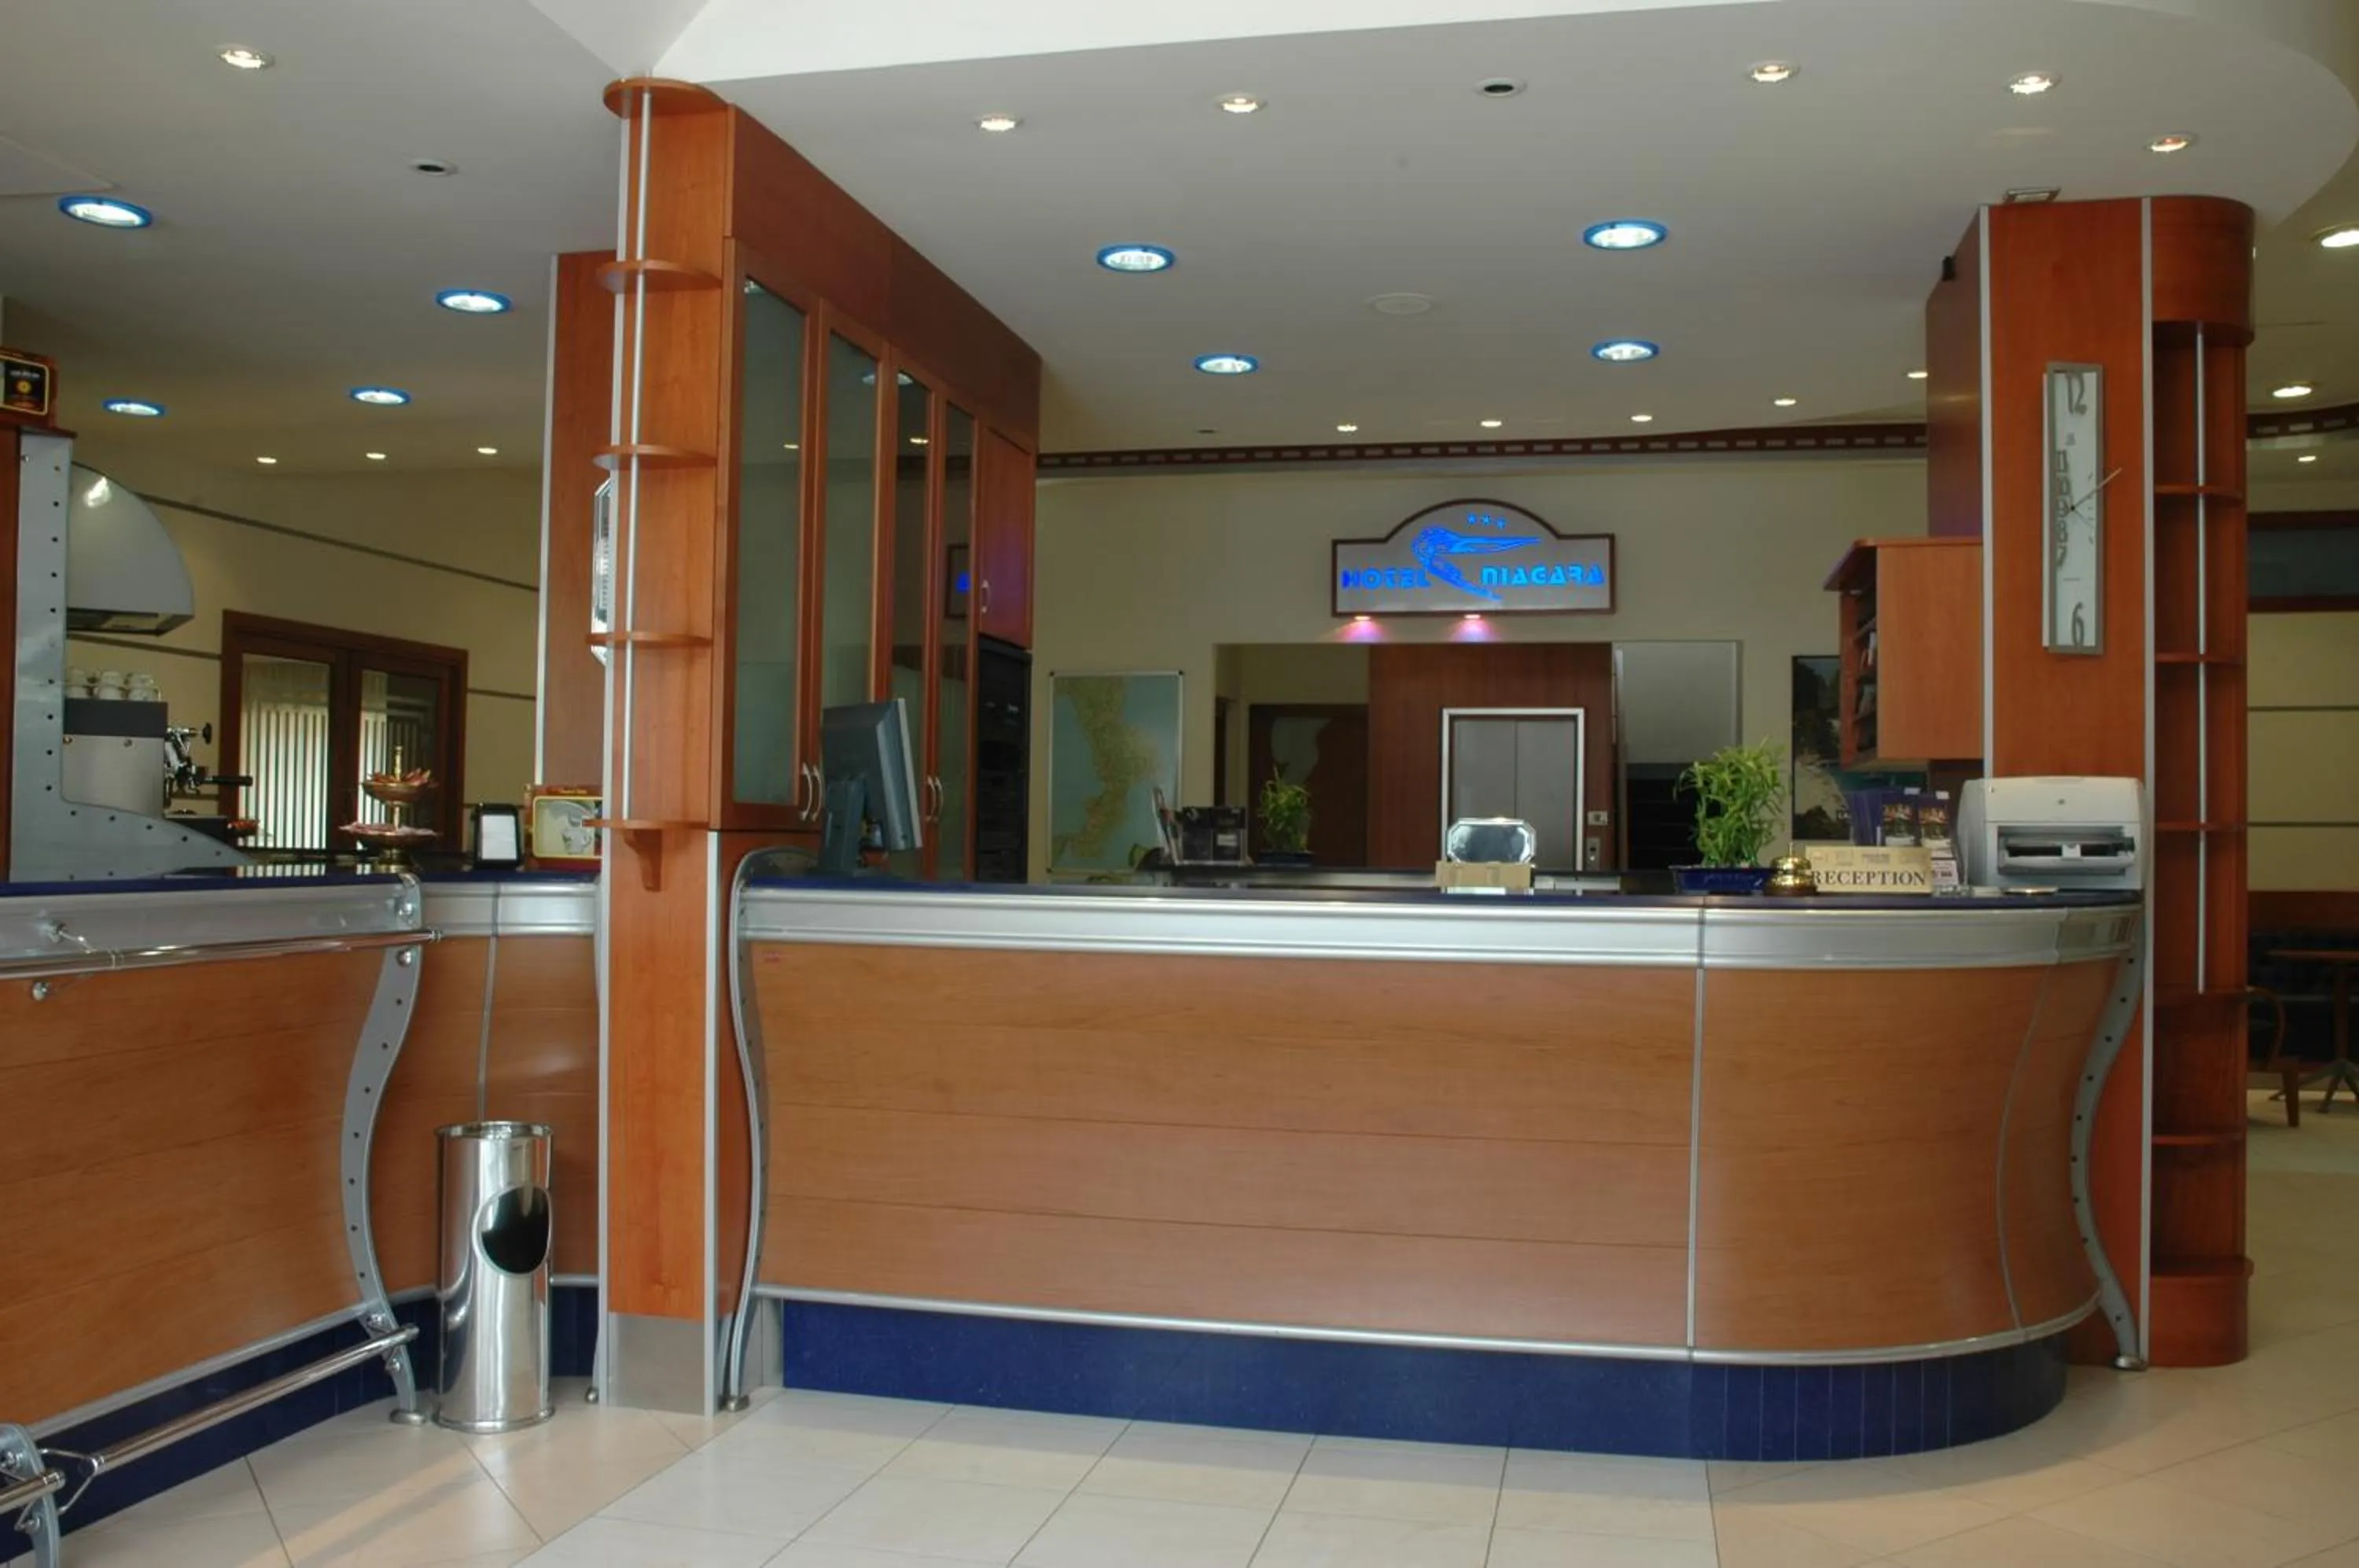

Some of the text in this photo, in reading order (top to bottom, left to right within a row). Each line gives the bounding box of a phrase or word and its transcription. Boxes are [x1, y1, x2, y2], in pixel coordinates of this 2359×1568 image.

[1341, 563, 1604, 589] HOTEL NIAGARA
[1811, 870, 1926, 885] RECEPTION
